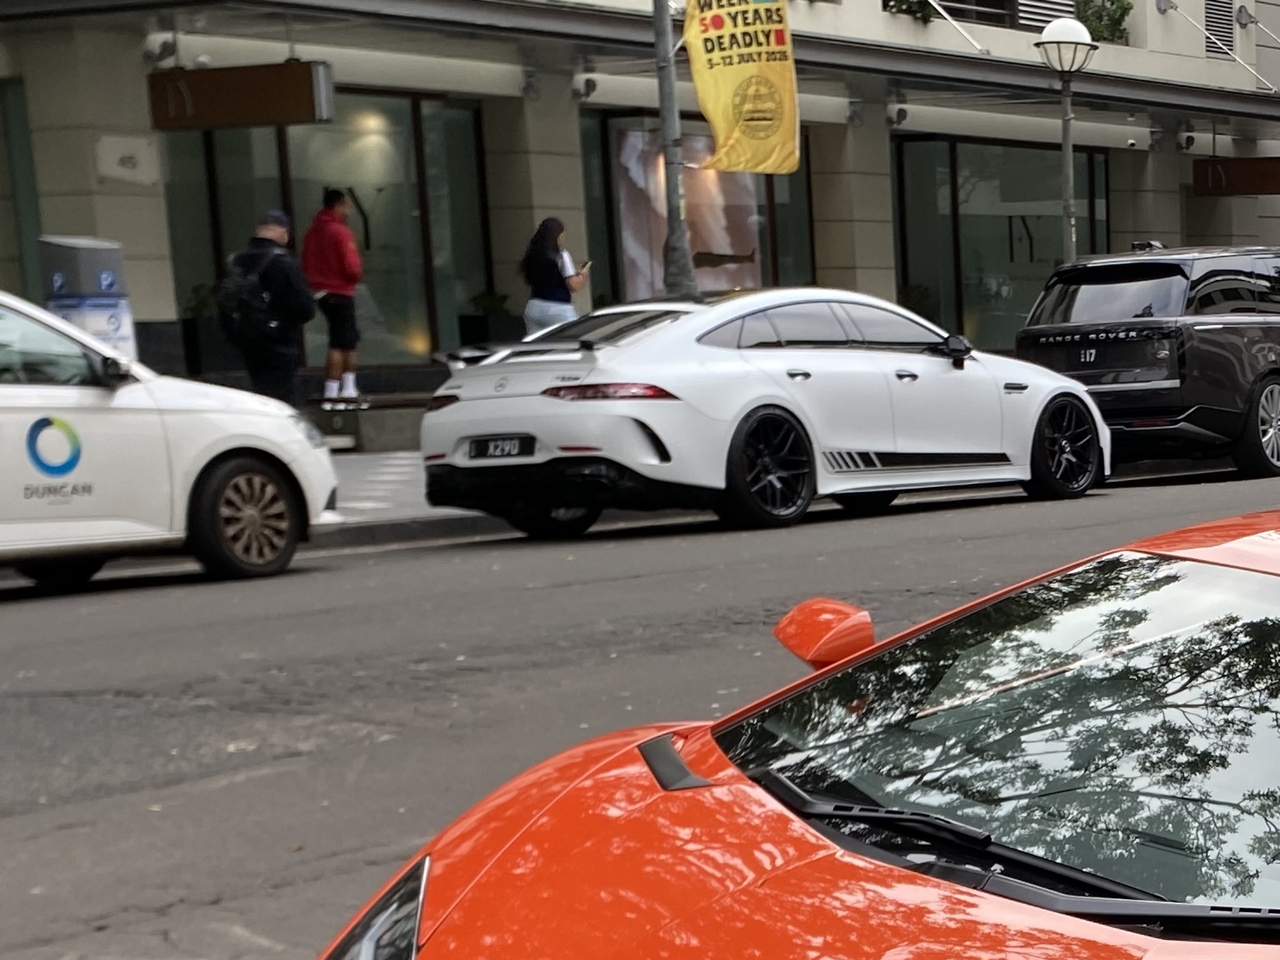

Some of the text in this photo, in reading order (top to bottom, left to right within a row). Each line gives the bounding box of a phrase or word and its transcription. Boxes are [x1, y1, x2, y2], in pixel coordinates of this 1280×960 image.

[727, 8, 783, 28] YEARS
[704, 30, 772, 54] DEADLY
[737, 53, 762, 66] JULY
[1039, 331, 1137, 344] RANGE ROVER
